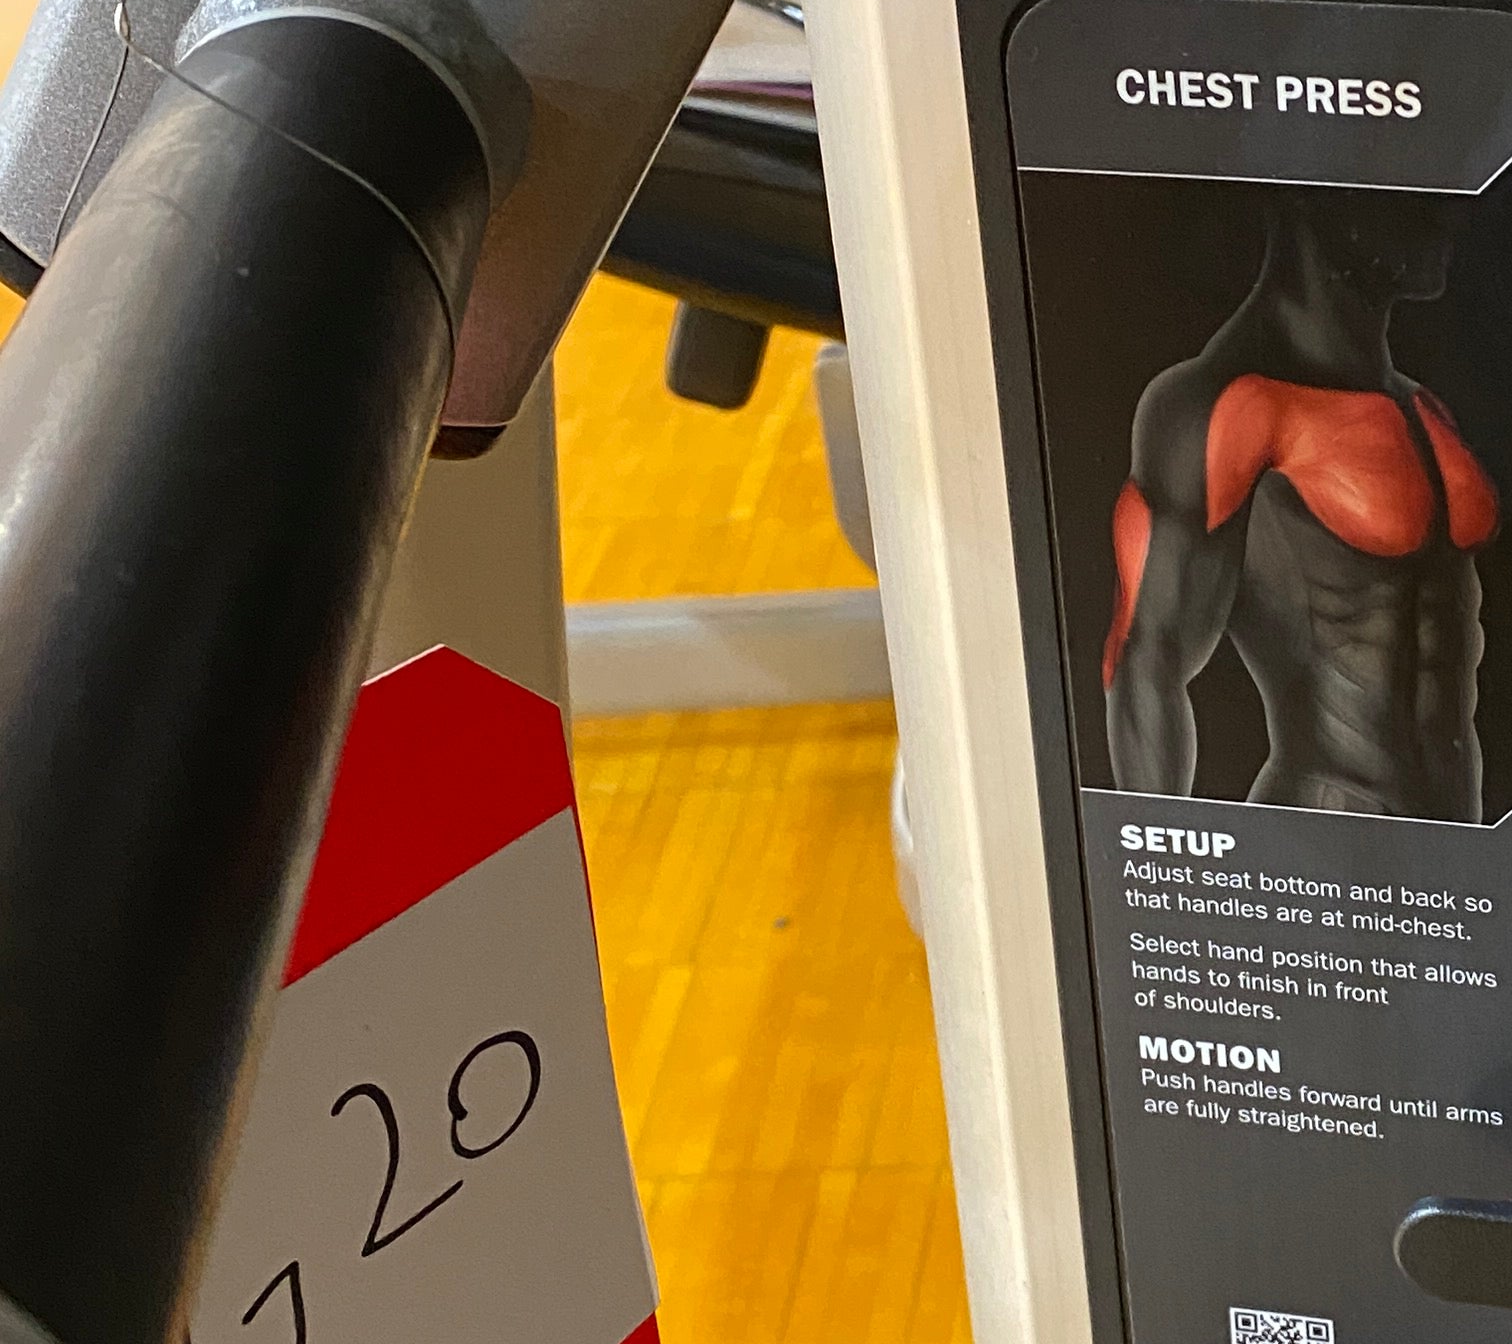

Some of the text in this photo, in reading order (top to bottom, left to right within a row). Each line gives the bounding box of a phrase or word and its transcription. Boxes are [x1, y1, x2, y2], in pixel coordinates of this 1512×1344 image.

[1116, 68, 1422, 119] CHEST PRESS
[1119, 823, 1236, 859] SETUP
[1123, 859, 1493, 914] Adjust seat bottom and back so
[1124, 888, 1472, 942] that handles are at mid-chest.
[1129, 931, 1498, 988] Select hand position that allows
[1131, 959, 1390, 1006] hands to finish in front
[1134, 988, 1282, 1021] of shoulders.
[1138, 1034, 1281, 1074] MOTION
[1141, 1067, 1504, 1126] Push handles forward until arms
[1143, 1098, 1385, 1140] are fully straightened.
